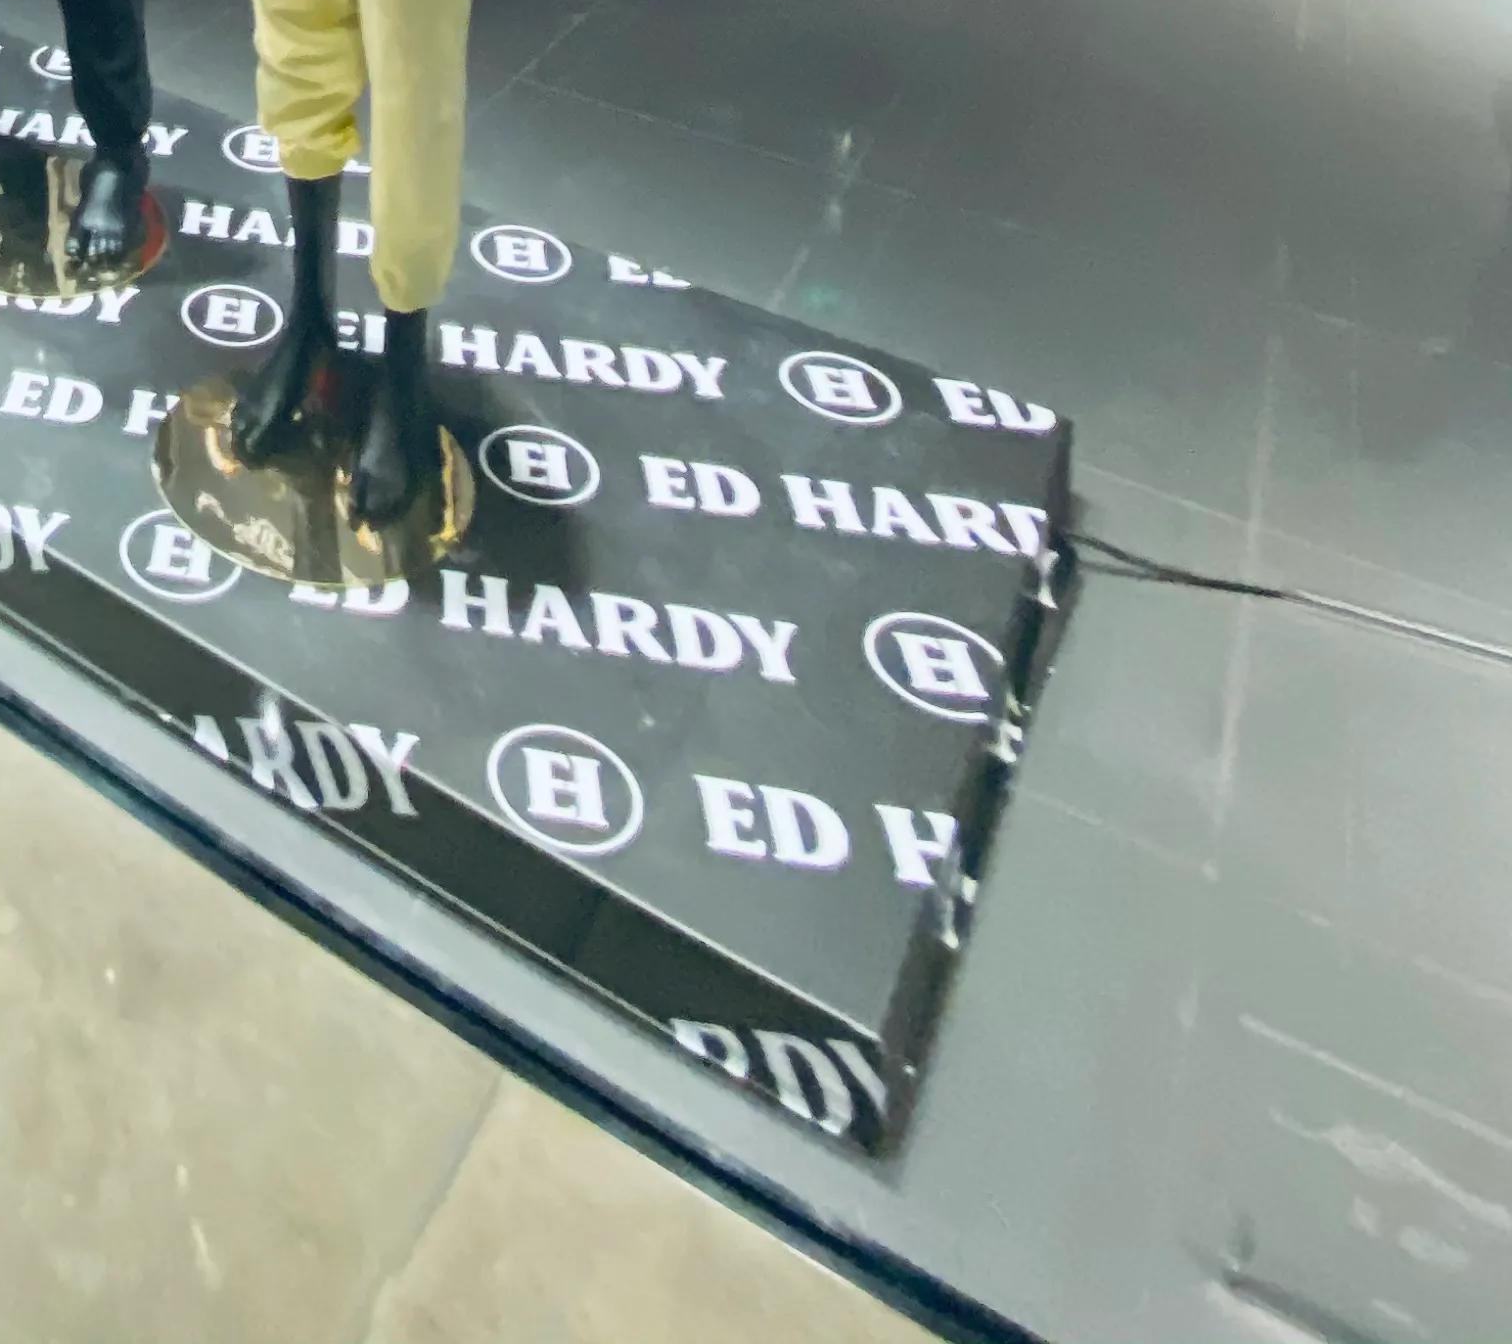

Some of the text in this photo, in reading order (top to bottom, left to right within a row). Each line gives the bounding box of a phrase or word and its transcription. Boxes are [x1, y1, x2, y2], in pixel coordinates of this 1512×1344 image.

[0, 369, 104, 424] ED
[439, 322, 728, 400] HARDY
[638, 454, 762, 518] ED
[438, 568, 799, 686] HARDY
[693, 773, 852, 872] ED
